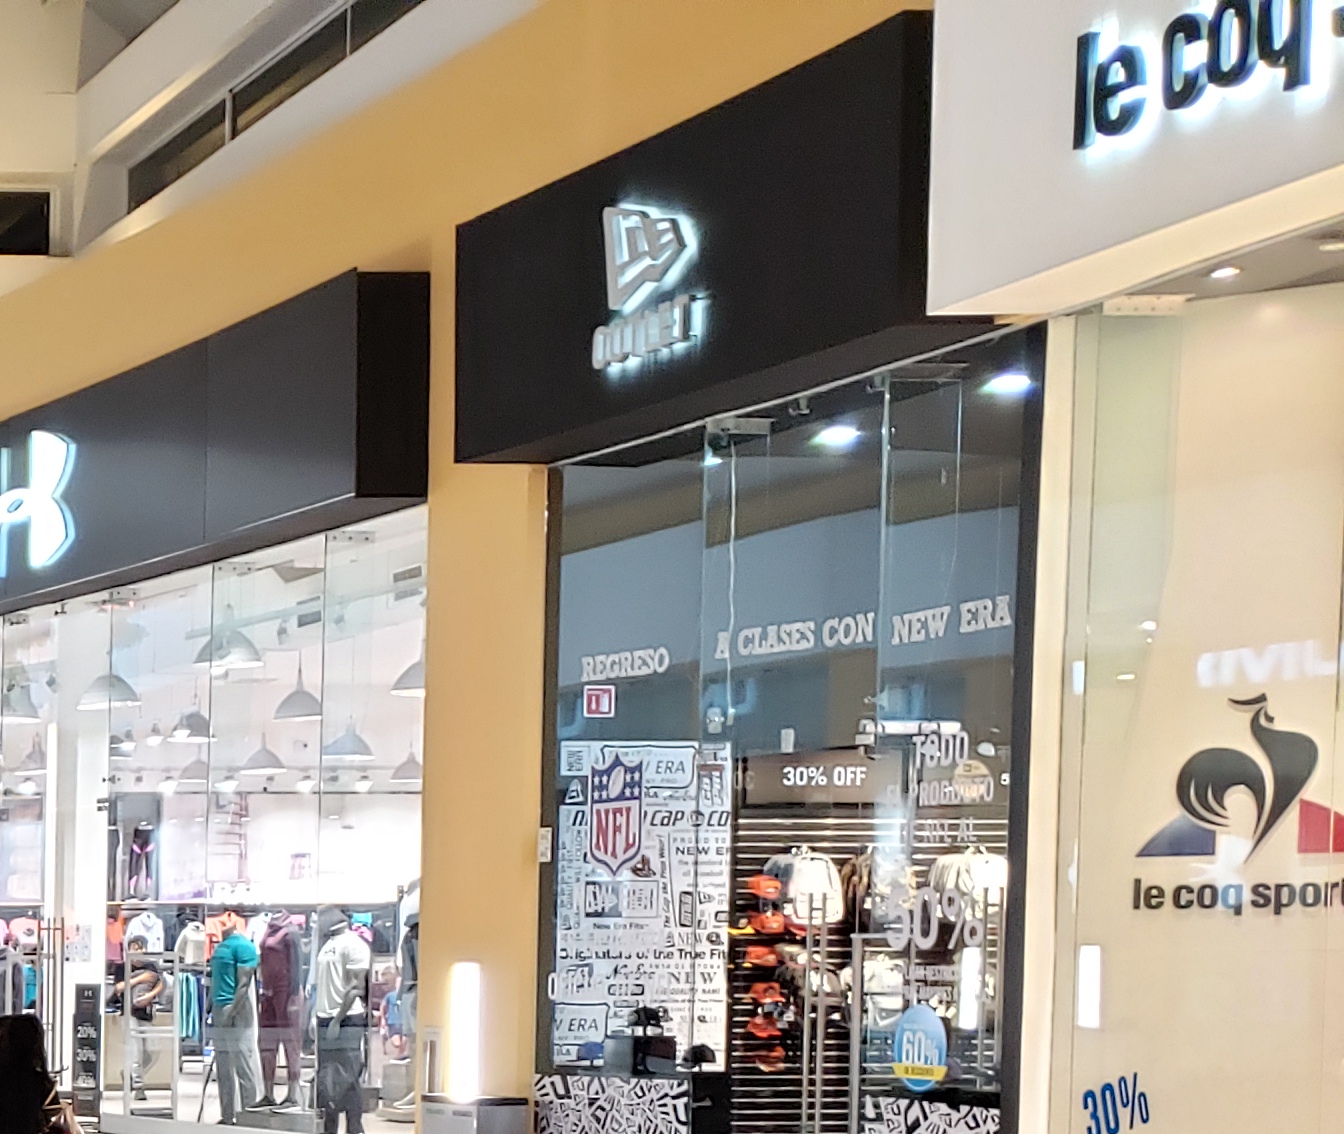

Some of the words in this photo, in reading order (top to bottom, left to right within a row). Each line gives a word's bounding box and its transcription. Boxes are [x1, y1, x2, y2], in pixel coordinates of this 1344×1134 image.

[1073, 31, 1146, 150] le
[1163, 0, 1311, 110] coq
[592, 294, 691, 371] OUTLET
[580, 646, 670, 683] REGRESO
[714, 630, 732, 660] A
[737, 621, 816, 656] CLASES
[823, 612, 876, 648] CON
[891, 605, 952, 646] NEW
[959, 594, 1012, 634] ERA
[655, 760, 686, 775] ERA
[913, 731, 970, 769] TODO
[782, 766, 827, 787] 30%
[832, 766, 868, 786] OFF
[594, 805, 637, 861] NFL
[675, 846, 710, 856] NEW
[1132, 877, 1166, 911] le
[1172, 882, 1244, 916] coq
[886, 886, 984, 950] 50%
[678, 947, 706, 960] True
[567, 1017, 599, 1032] ERA
[901, 1030, 940, 1066] 60%
